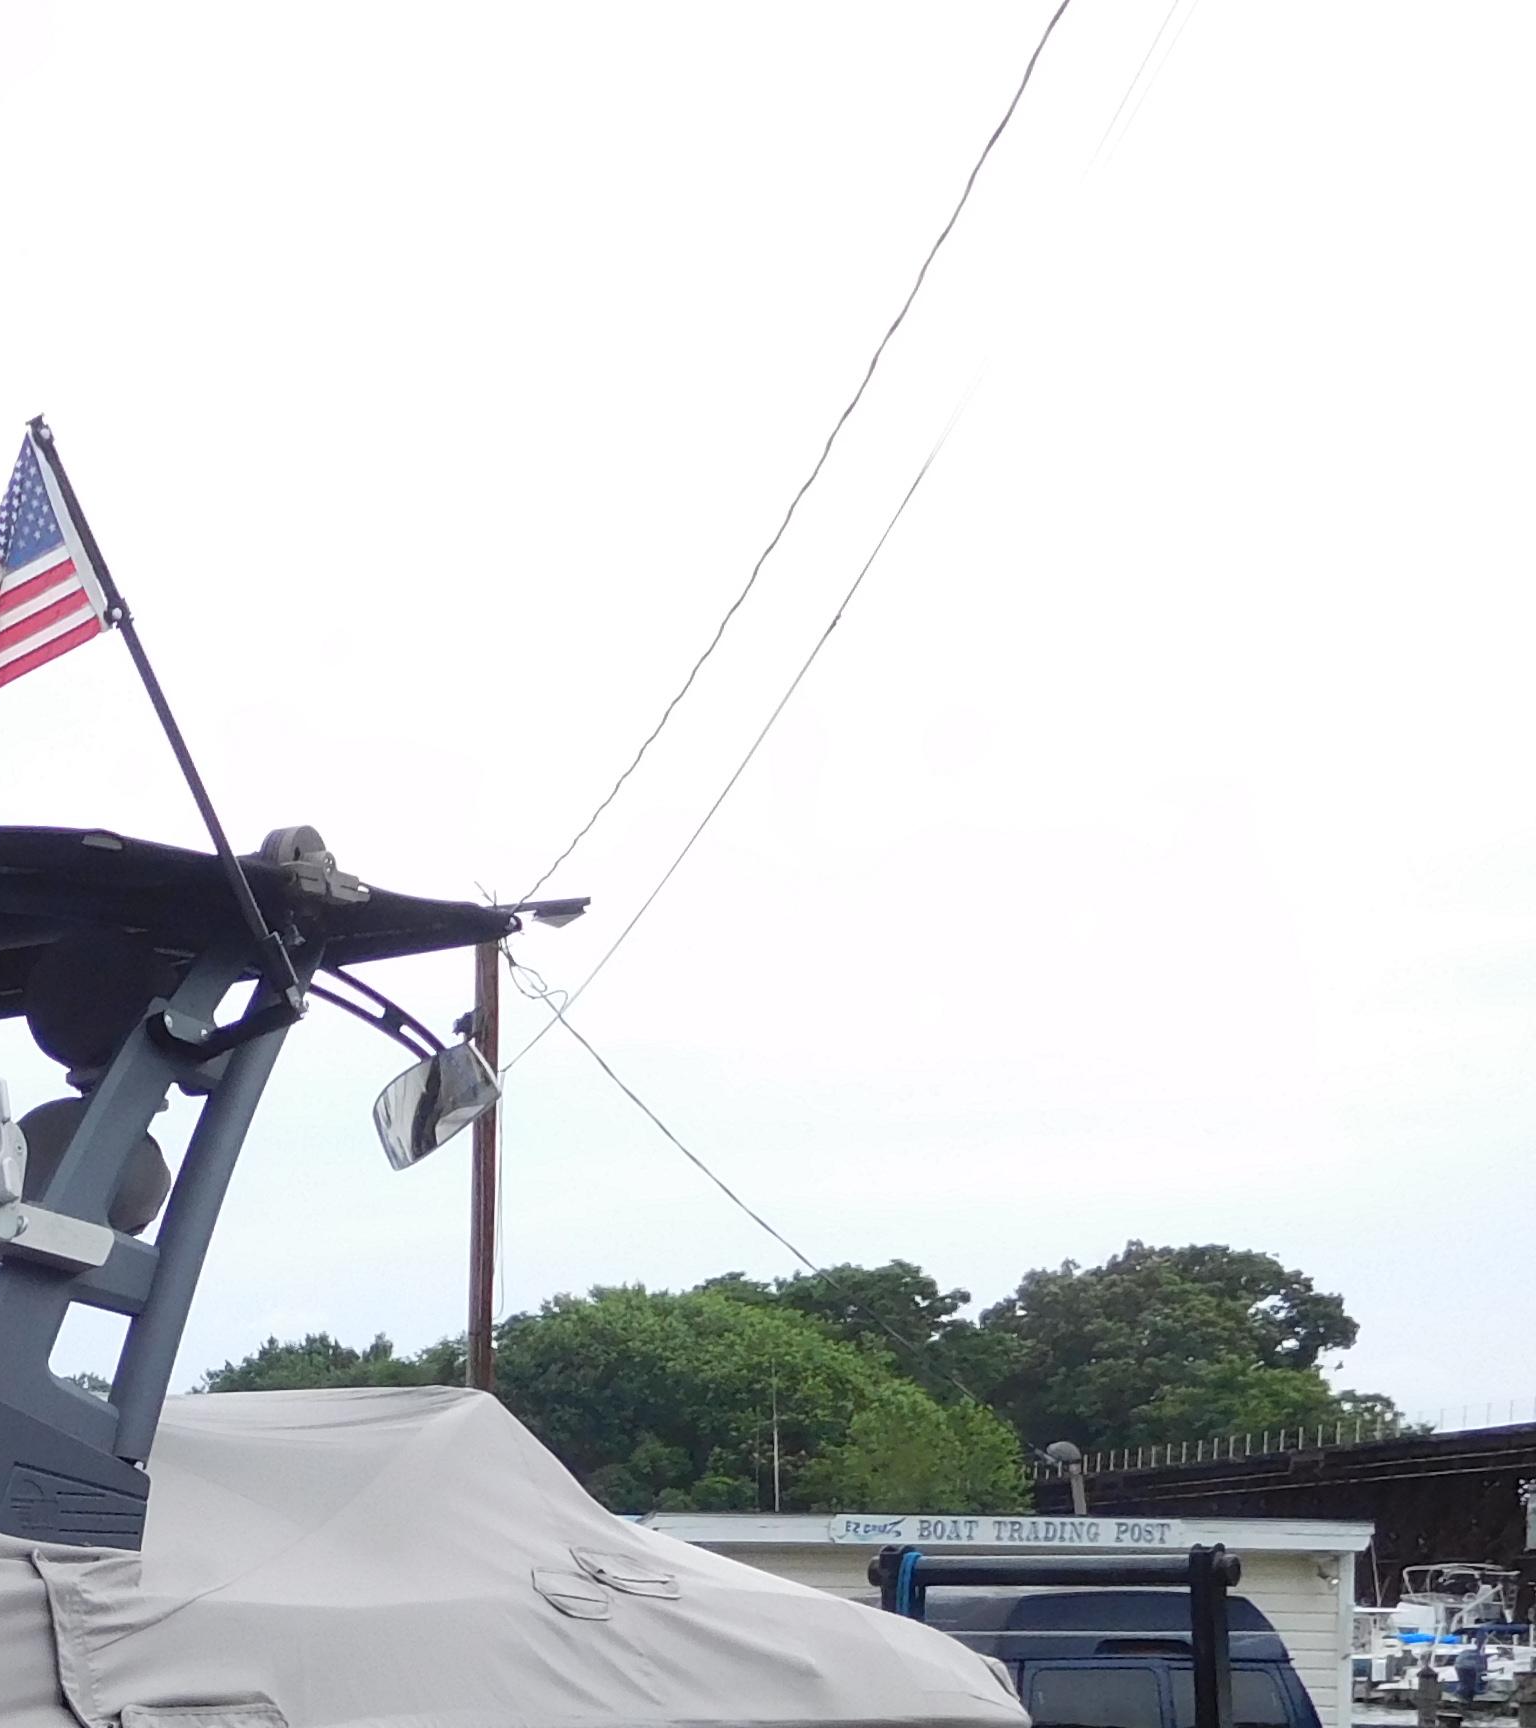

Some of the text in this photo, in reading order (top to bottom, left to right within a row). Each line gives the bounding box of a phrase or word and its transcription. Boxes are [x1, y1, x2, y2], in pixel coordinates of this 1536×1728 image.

[917, 1518, 979, 1541] BOAT
[993, 1519, 1100, 1542] TRADING
[1114, 1522, 1171, 1544] POST
